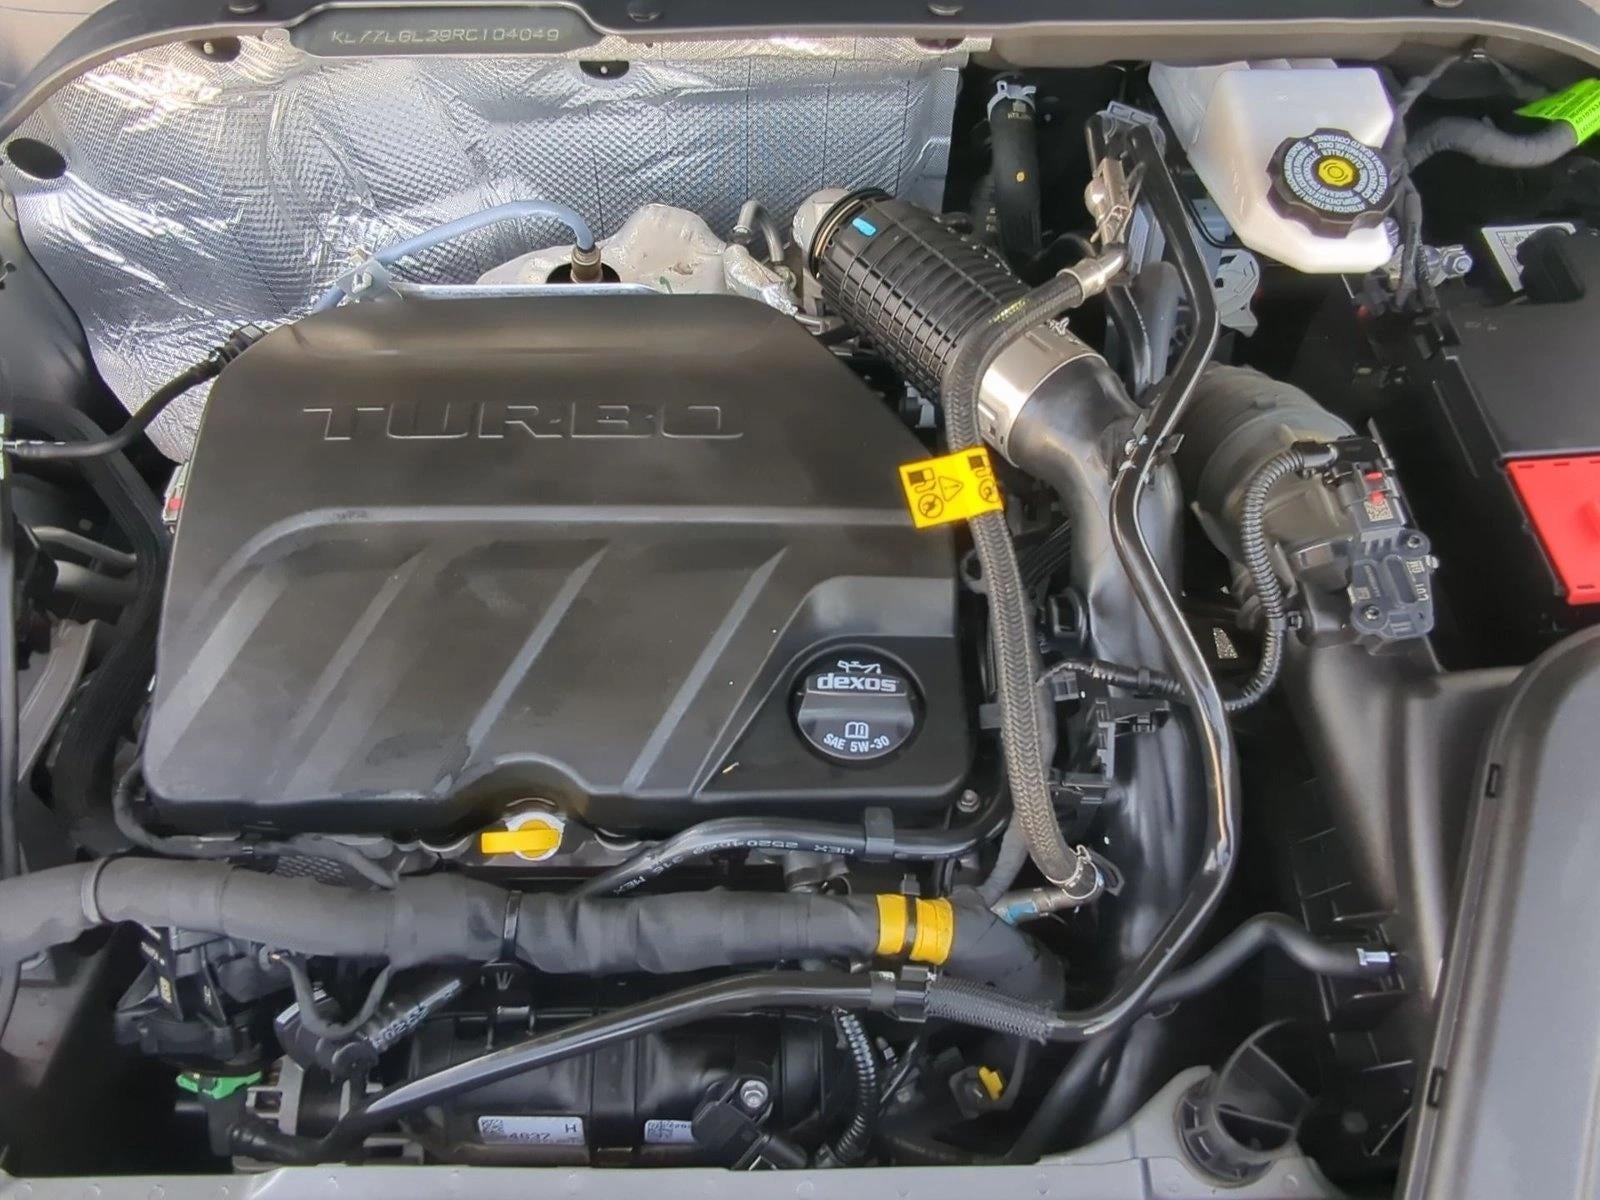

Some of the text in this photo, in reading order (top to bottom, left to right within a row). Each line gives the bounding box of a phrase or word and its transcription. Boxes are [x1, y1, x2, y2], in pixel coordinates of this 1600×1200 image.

[303, 401, 744, 441] TURBO
[817, 673, 896, 692] dexos
[823, 733, 890, 752] SAE 5W-30
